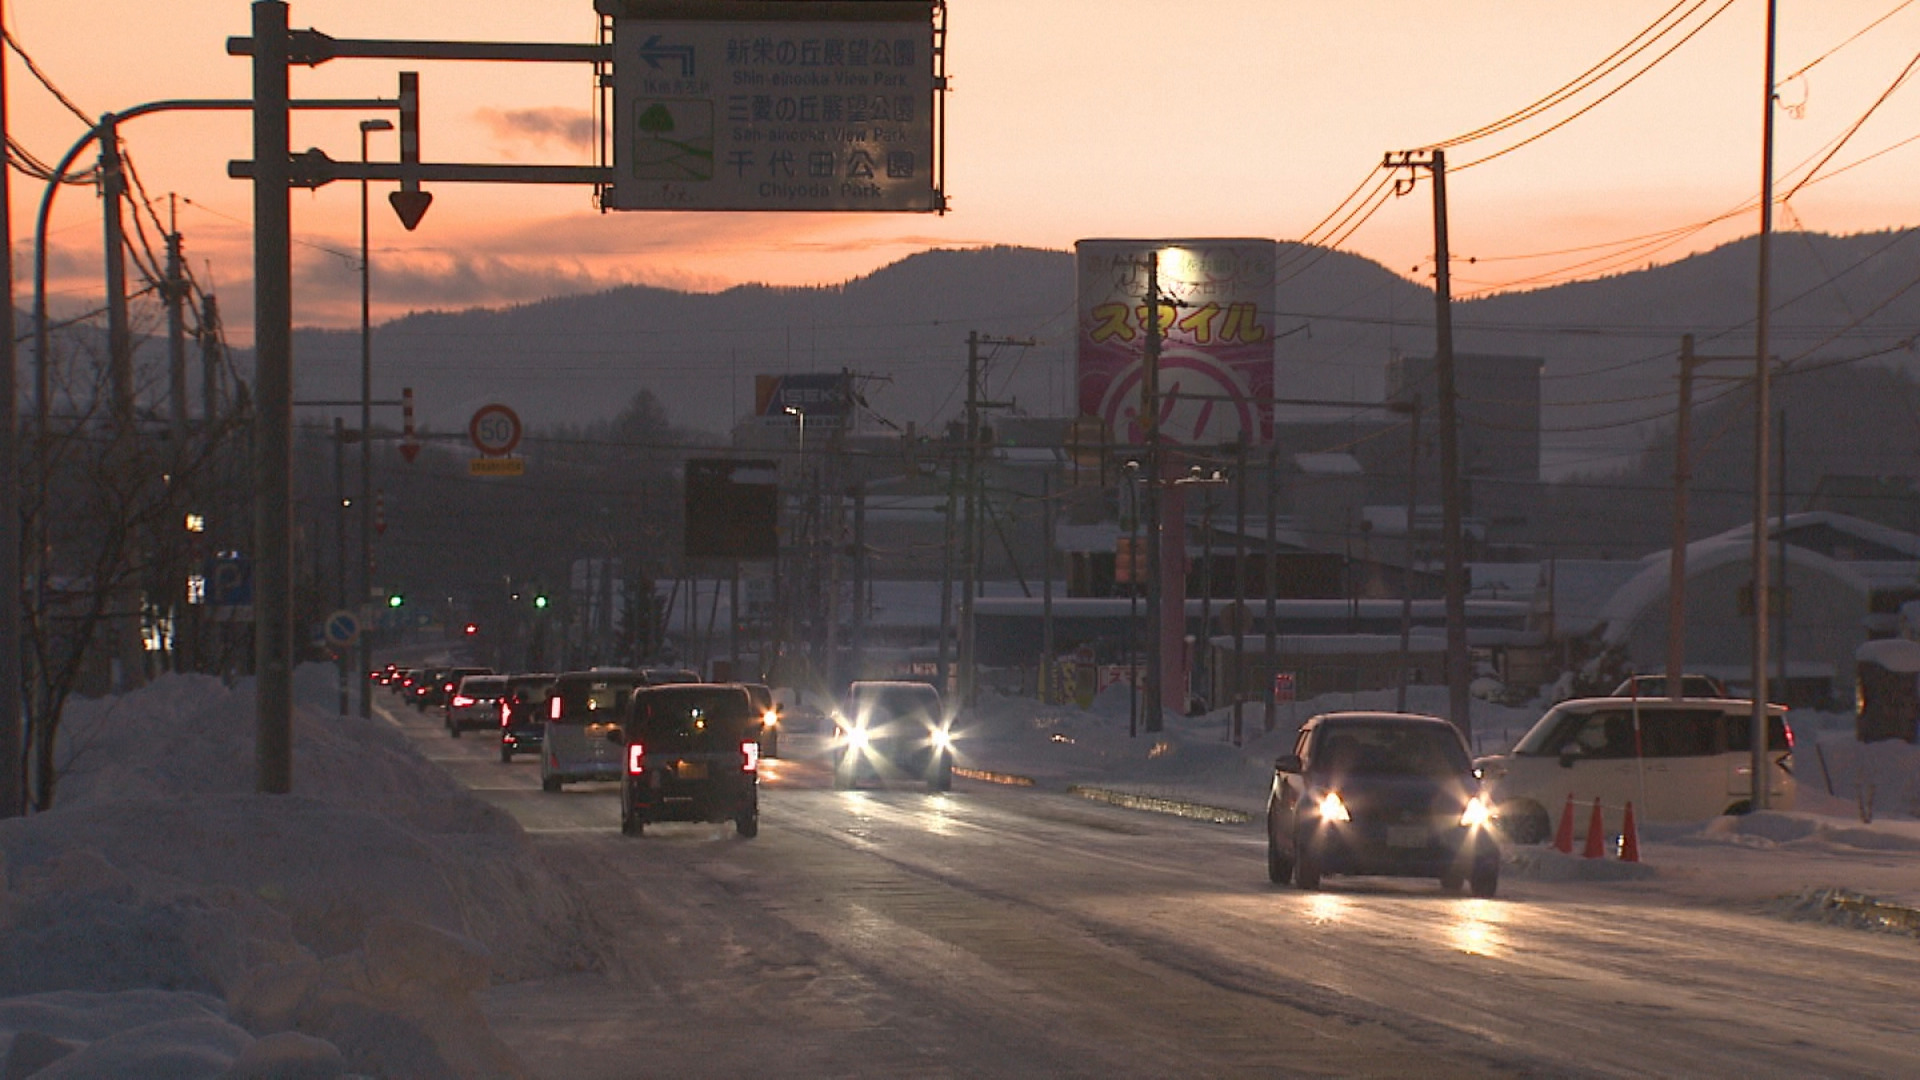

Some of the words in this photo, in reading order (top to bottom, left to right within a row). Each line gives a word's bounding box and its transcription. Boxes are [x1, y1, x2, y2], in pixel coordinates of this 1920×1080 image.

[834, 71, 869, 86] View
[874, 71, 907, 86] Park
[830, 127, 867, 142] View
[874, 127, 906, 142] Park
[726, 150, 914, 178] 千代田公園
[758, 182, 830, 199] Chiyoda
[840, 182, 882, 198] Park
[1090, 301, 1266, 344] スマイル
[780, 388, 840, 403] ISEK
[480, 417, 510, 442] 50
